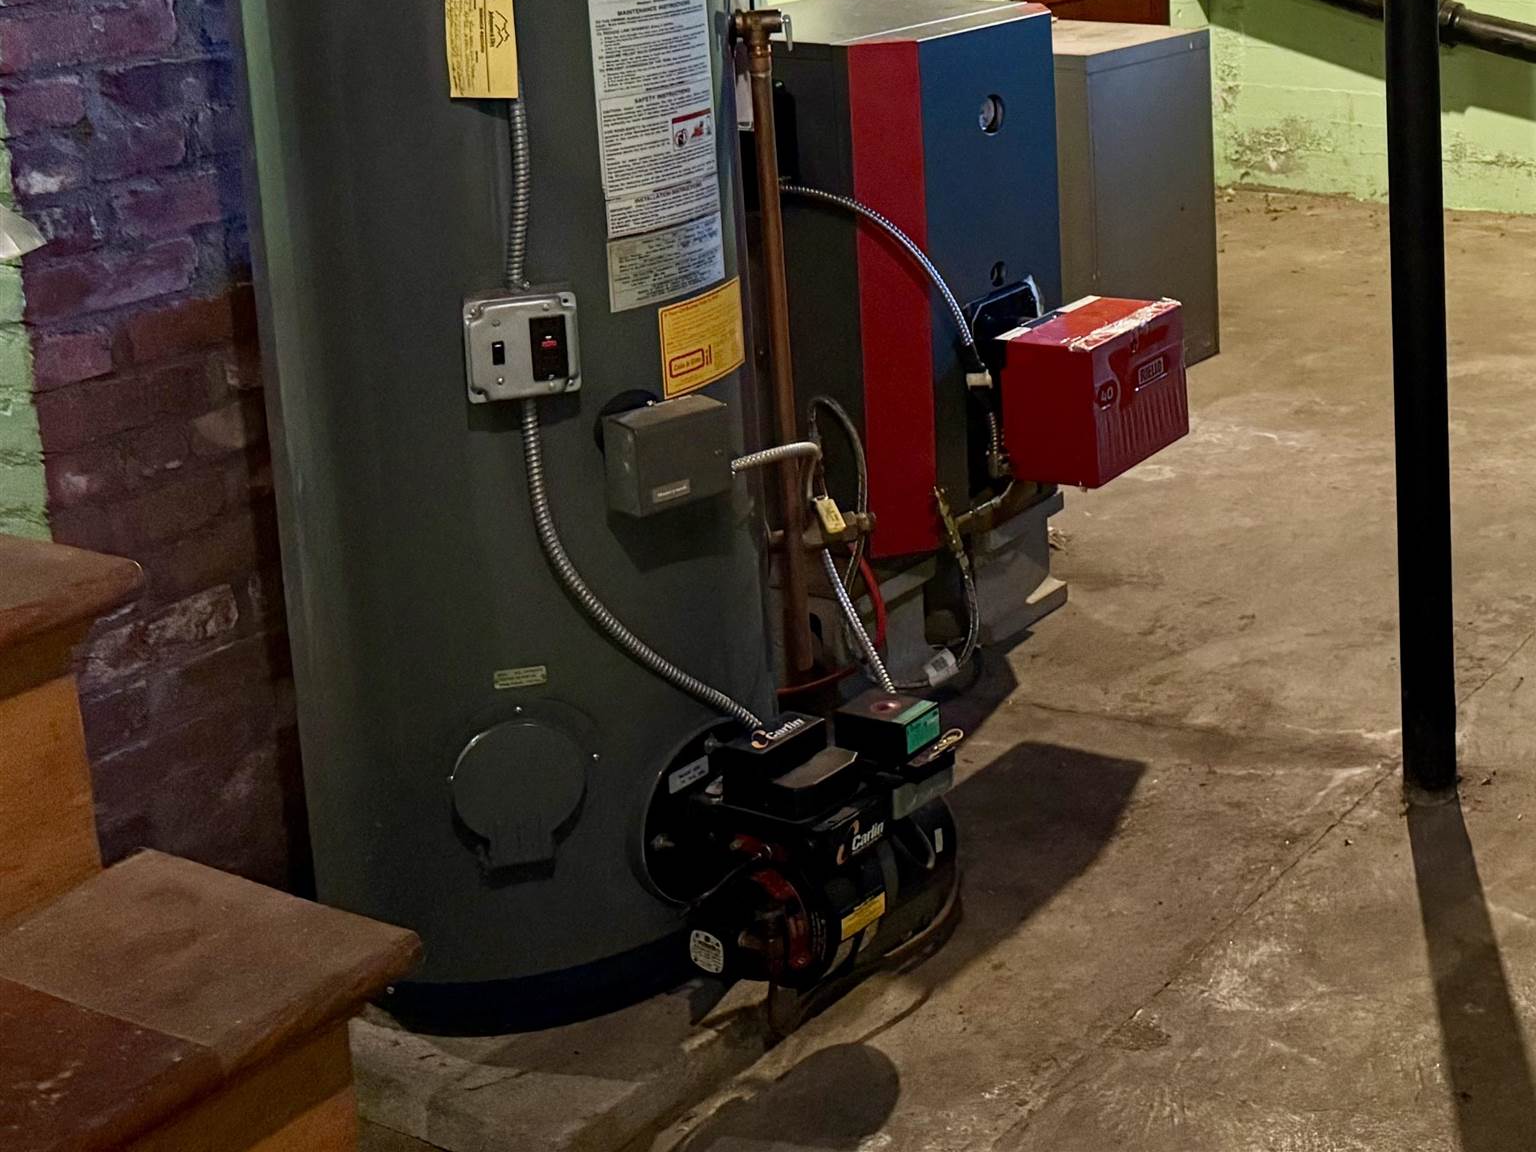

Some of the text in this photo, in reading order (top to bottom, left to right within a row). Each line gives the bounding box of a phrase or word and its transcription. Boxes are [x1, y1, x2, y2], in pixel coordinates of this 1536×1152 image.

[1101, 387, 1113, 401] 40
[765, 718, 805, 740] Carlin
[852, 822, 884, 850] Carlin
